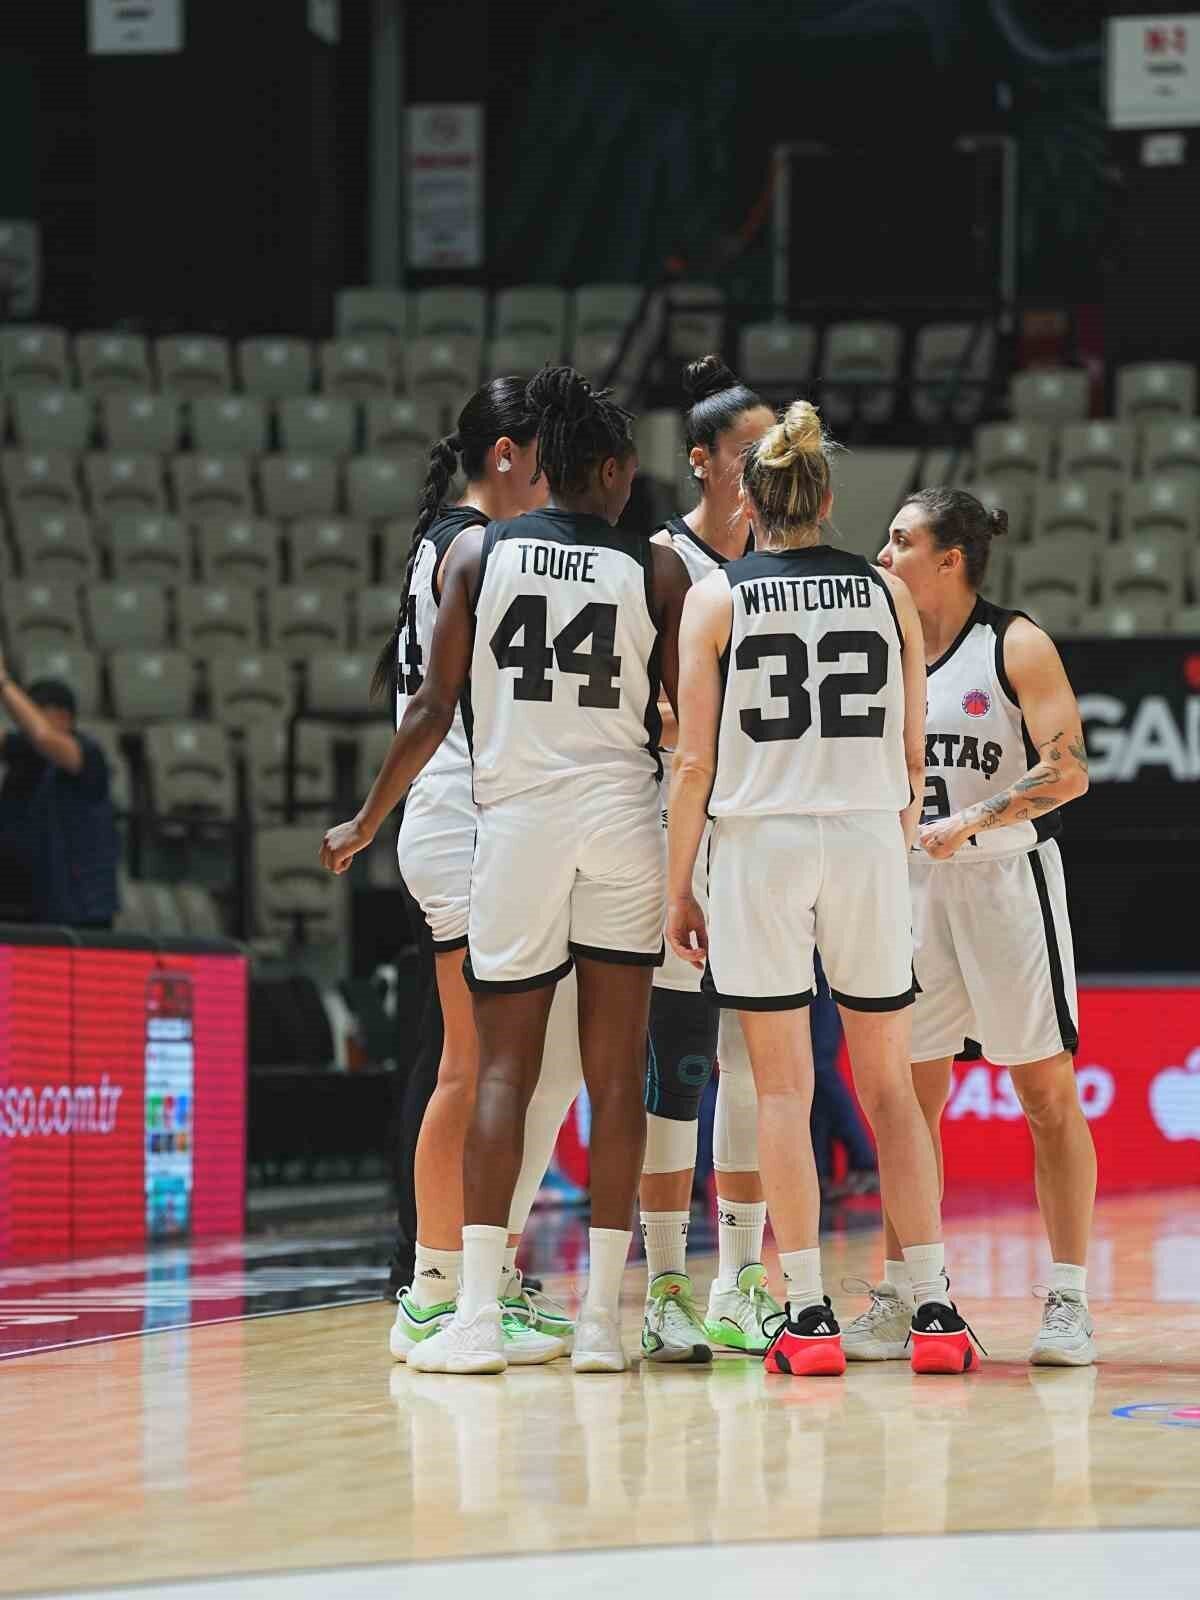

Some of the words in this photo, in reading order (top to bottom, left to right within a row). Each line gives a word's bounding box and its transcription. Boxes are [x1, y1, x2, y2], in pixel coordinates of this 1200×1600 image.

[518, 544, 598, 583] TOURÉ
[740, 577, 871, 615] WHITCOMB
[489, 594, 622, 709] 44
[736, 631, 889, 743] 32
